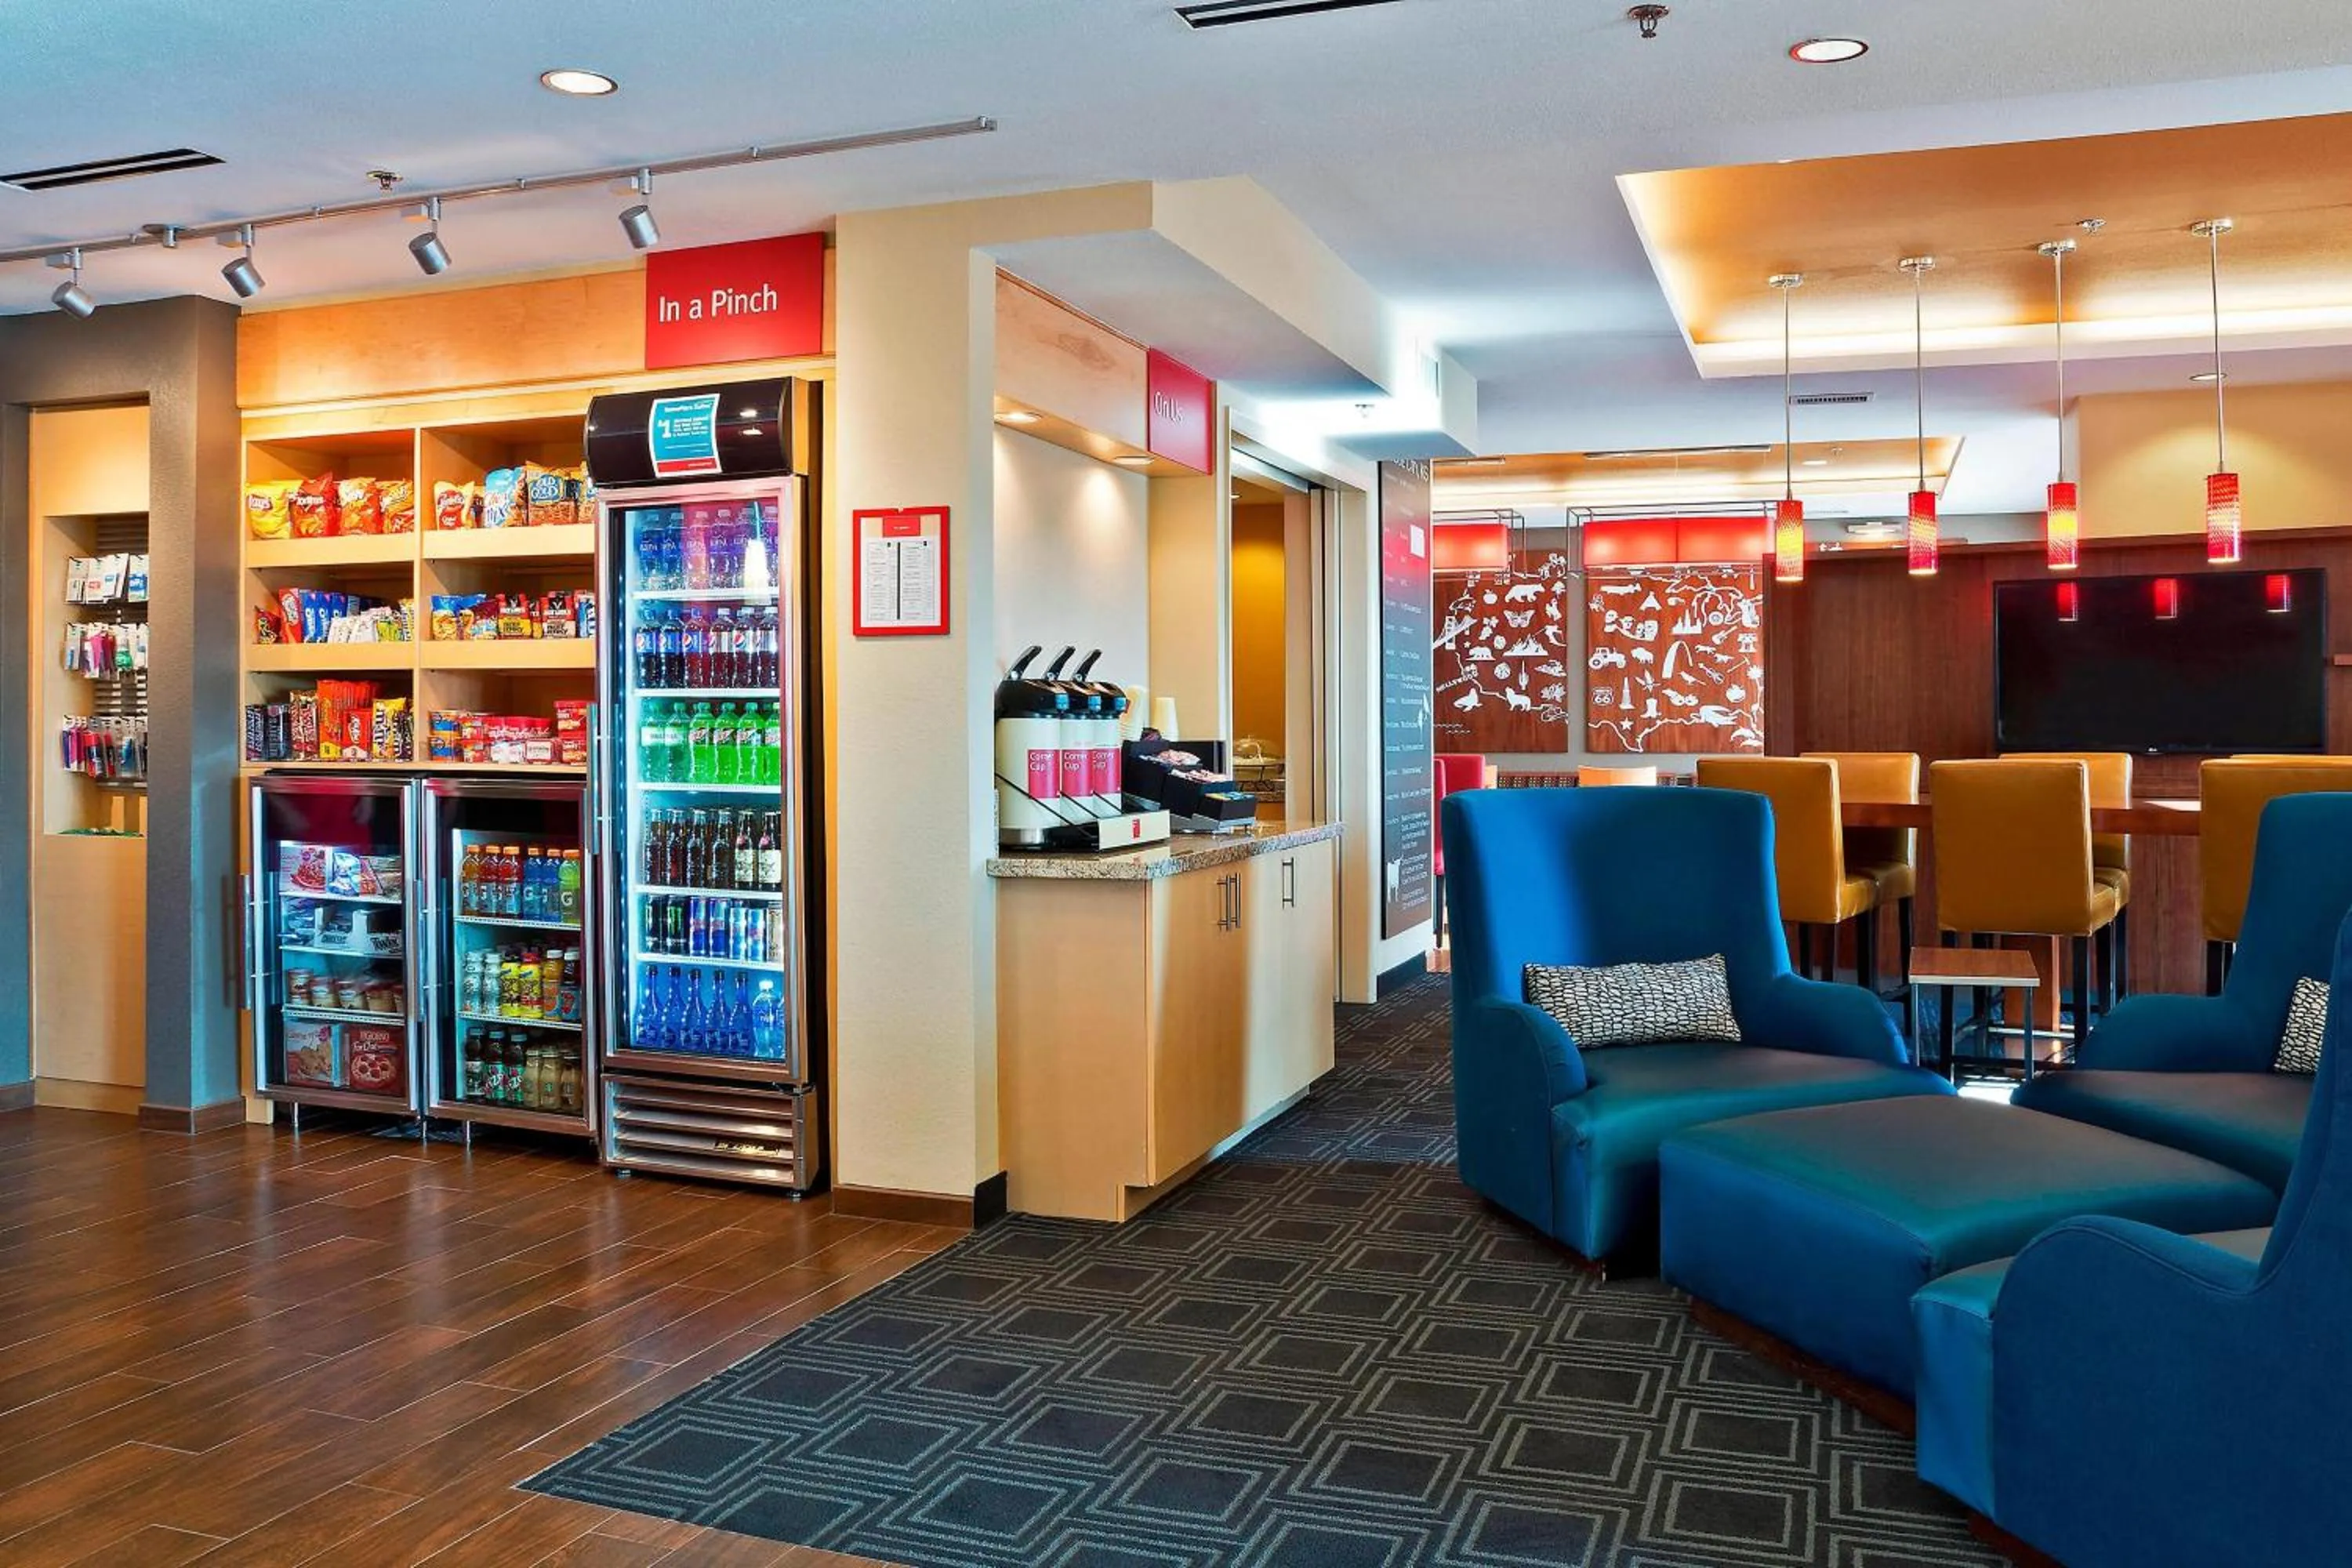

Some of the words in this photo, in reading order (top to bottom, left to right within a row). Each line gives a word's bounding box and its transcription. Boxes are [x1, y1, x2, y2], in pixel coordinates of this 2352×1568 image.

[659, 296, 680, 322] In
[689, 299, 702, 319] a
[711, 283, 777, 318] Pinch
[1154, 390, 1169, 418] On
[1171, 397, 1185, 424] Us
